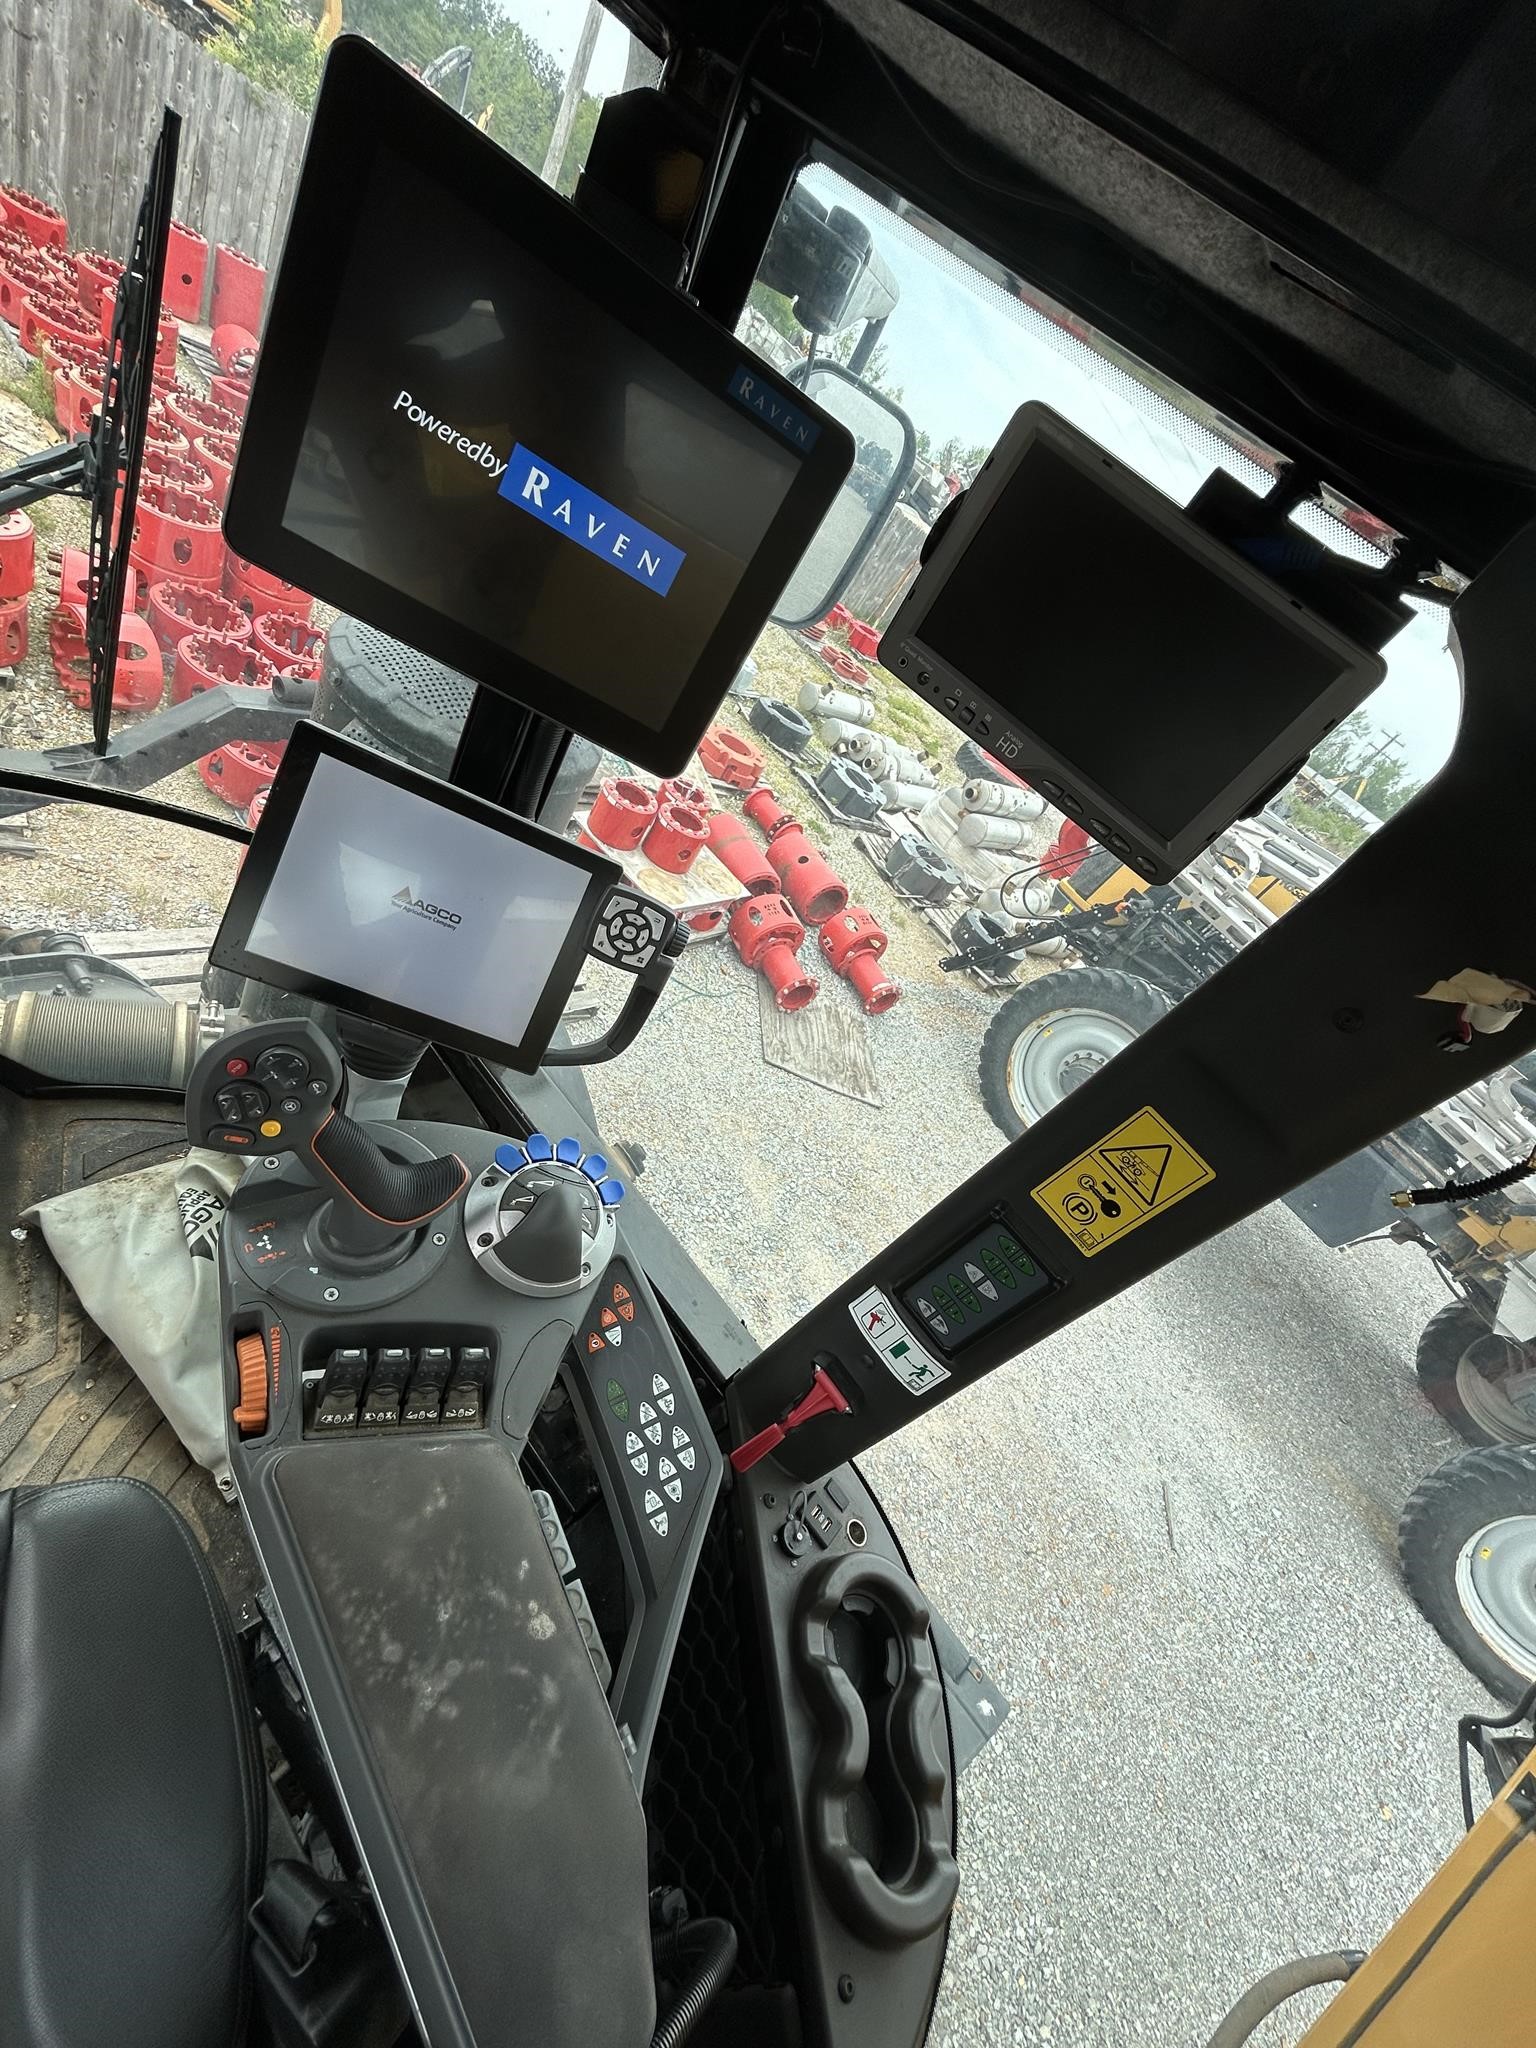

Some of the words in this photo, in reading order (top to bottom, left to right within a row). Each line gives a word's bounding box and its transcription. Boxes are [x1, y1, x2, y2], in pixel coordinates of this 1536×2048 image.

[739, 376, 809, 442] RAVEN
[521, 466, 661, 577] RAVEN
[995, 736, 1019, 759] HD
[402, 905, 433, 921] Agriculture
[432, 917, 457, 932] Company
[413, 899, 463, 925] AGCO
